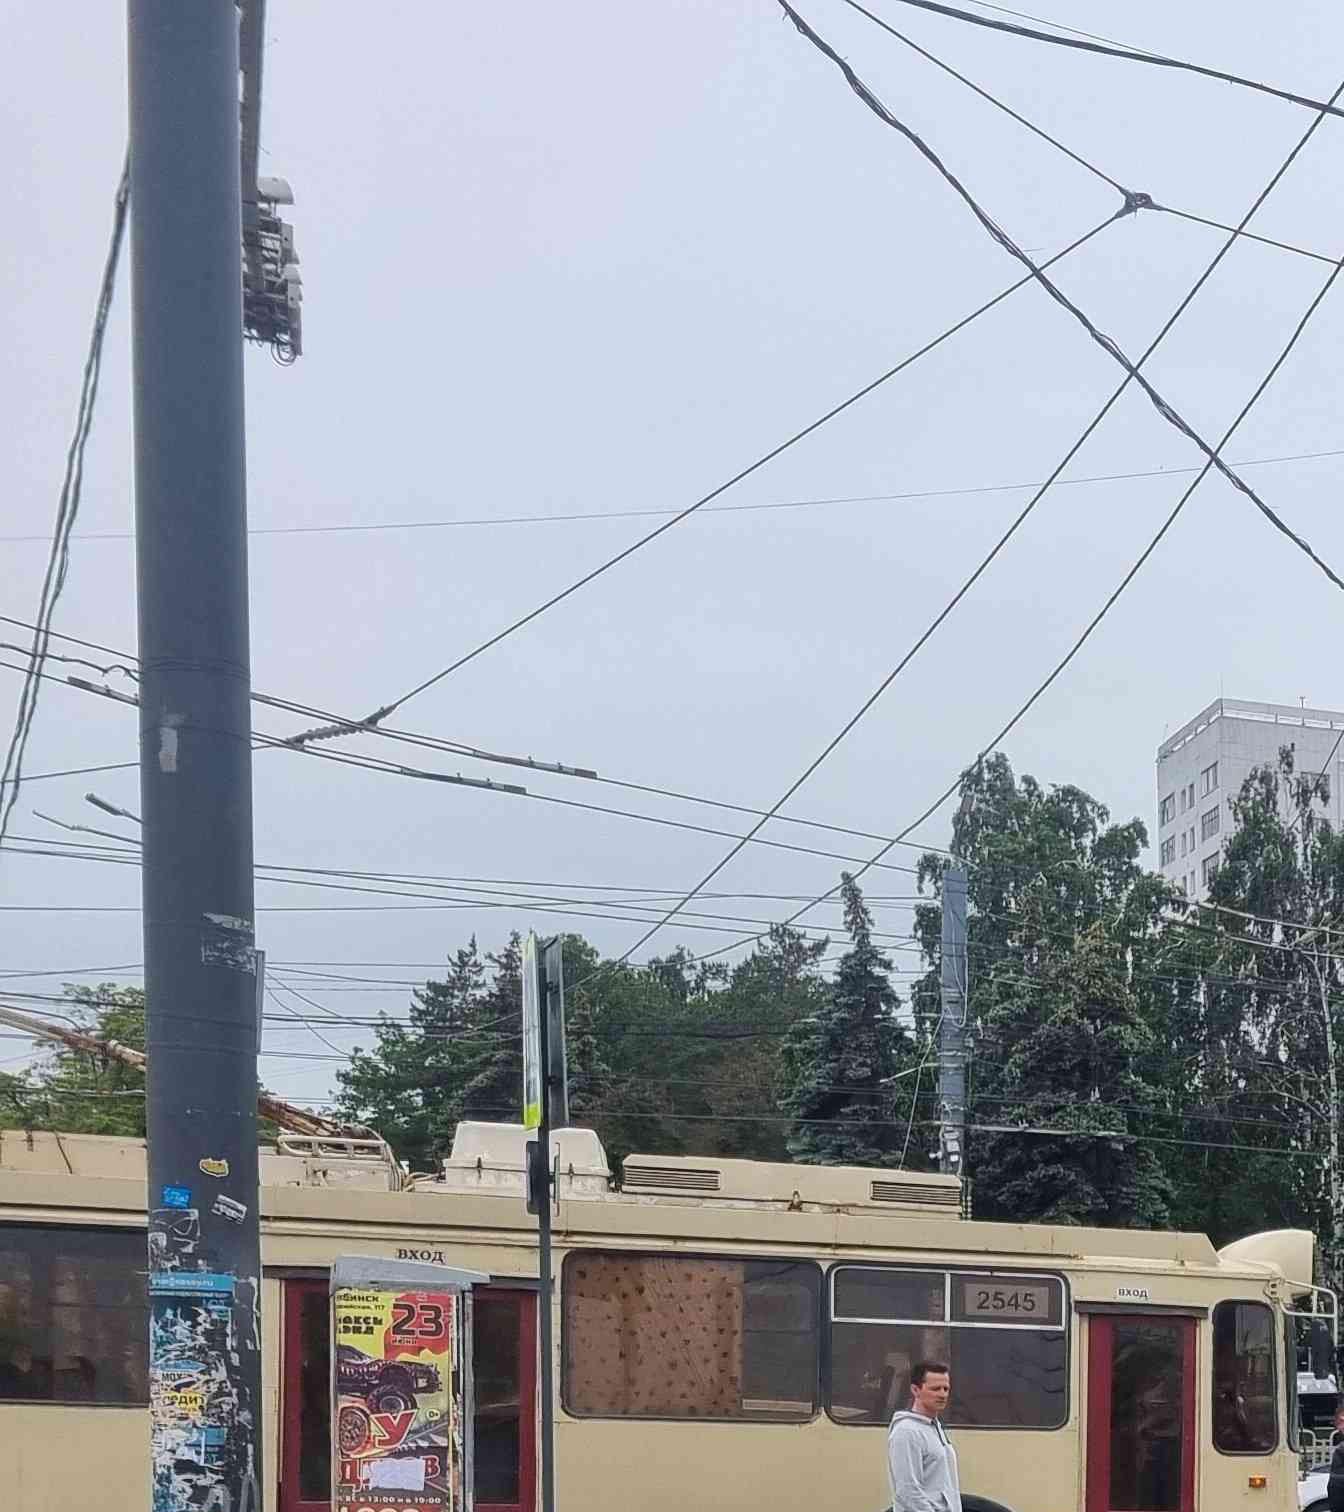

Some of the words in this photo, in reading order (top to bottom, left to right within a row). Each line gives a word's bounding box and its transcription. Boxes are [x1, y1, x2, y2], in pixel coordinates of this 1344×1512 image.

[399, 1249, 445, 1264] ВХОД
[976, 1291, 1036, 1312] 2545
[392, 1302, 443, 1337] 23
